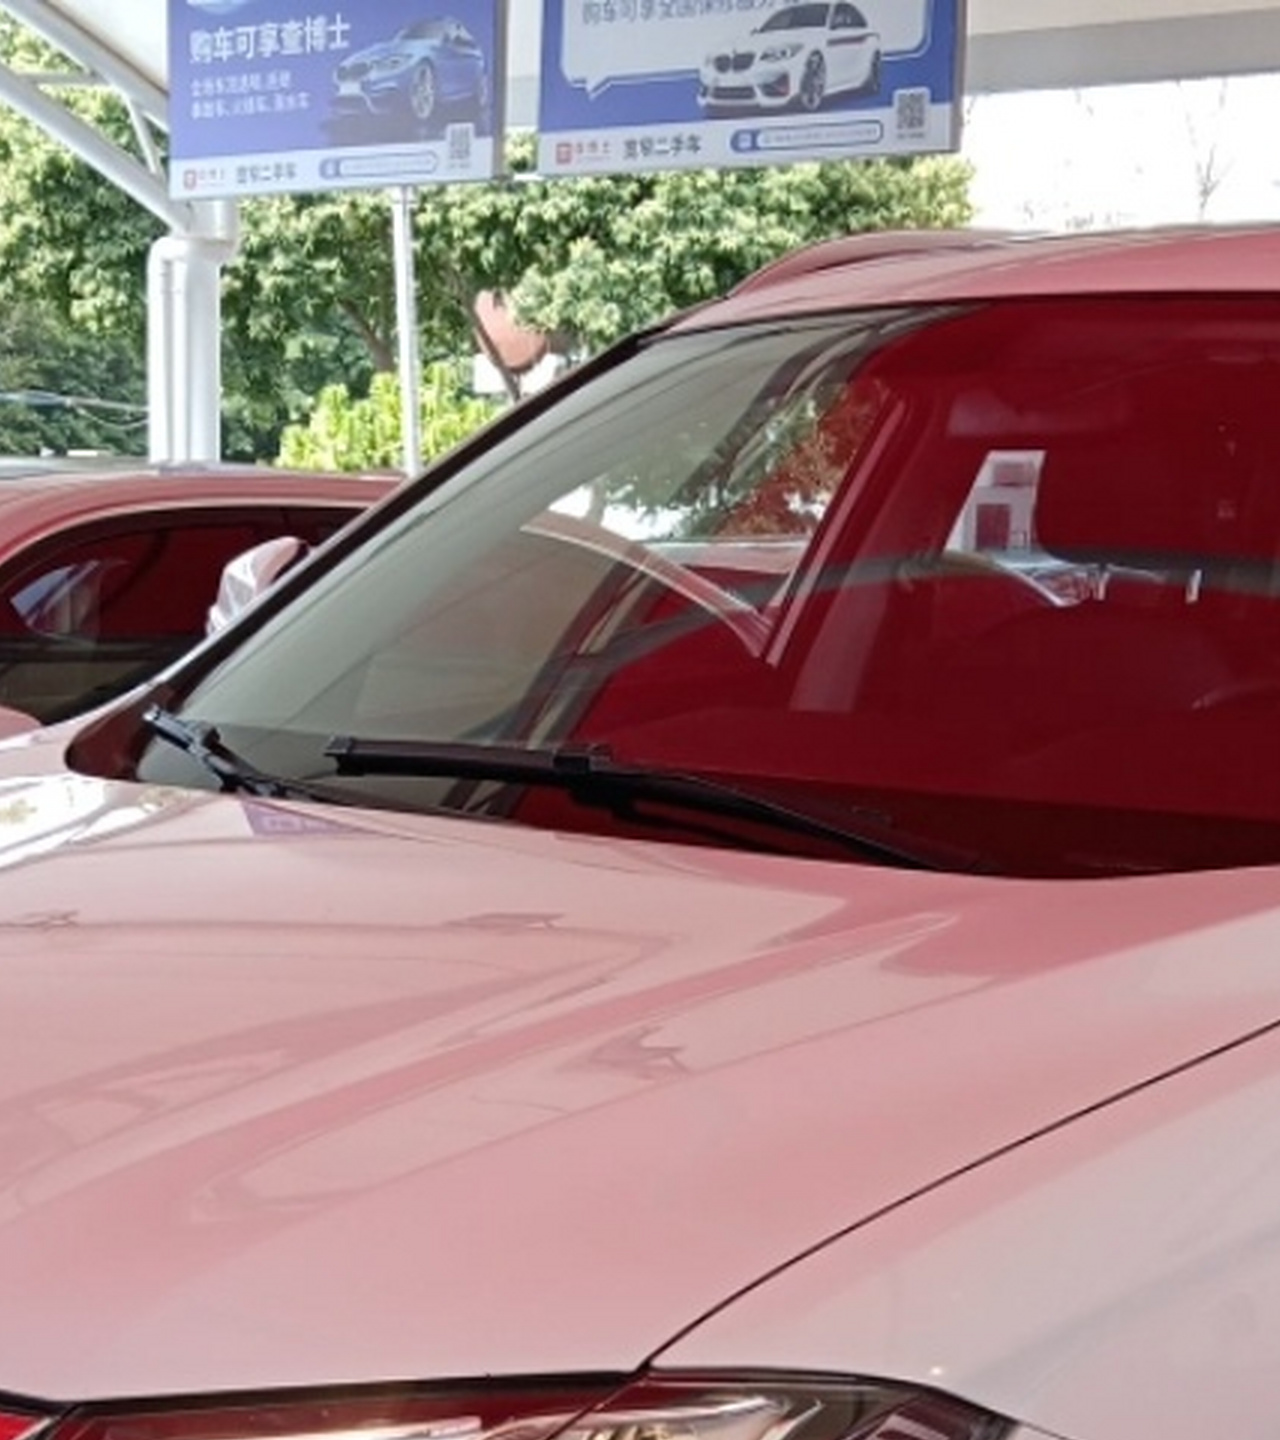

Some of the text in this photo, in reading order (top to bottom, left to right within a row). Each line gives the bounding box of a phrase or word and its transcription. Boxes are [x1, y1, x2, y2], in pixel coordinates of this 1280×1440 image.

[189, 12, 351, 64] 购车可享查博士
